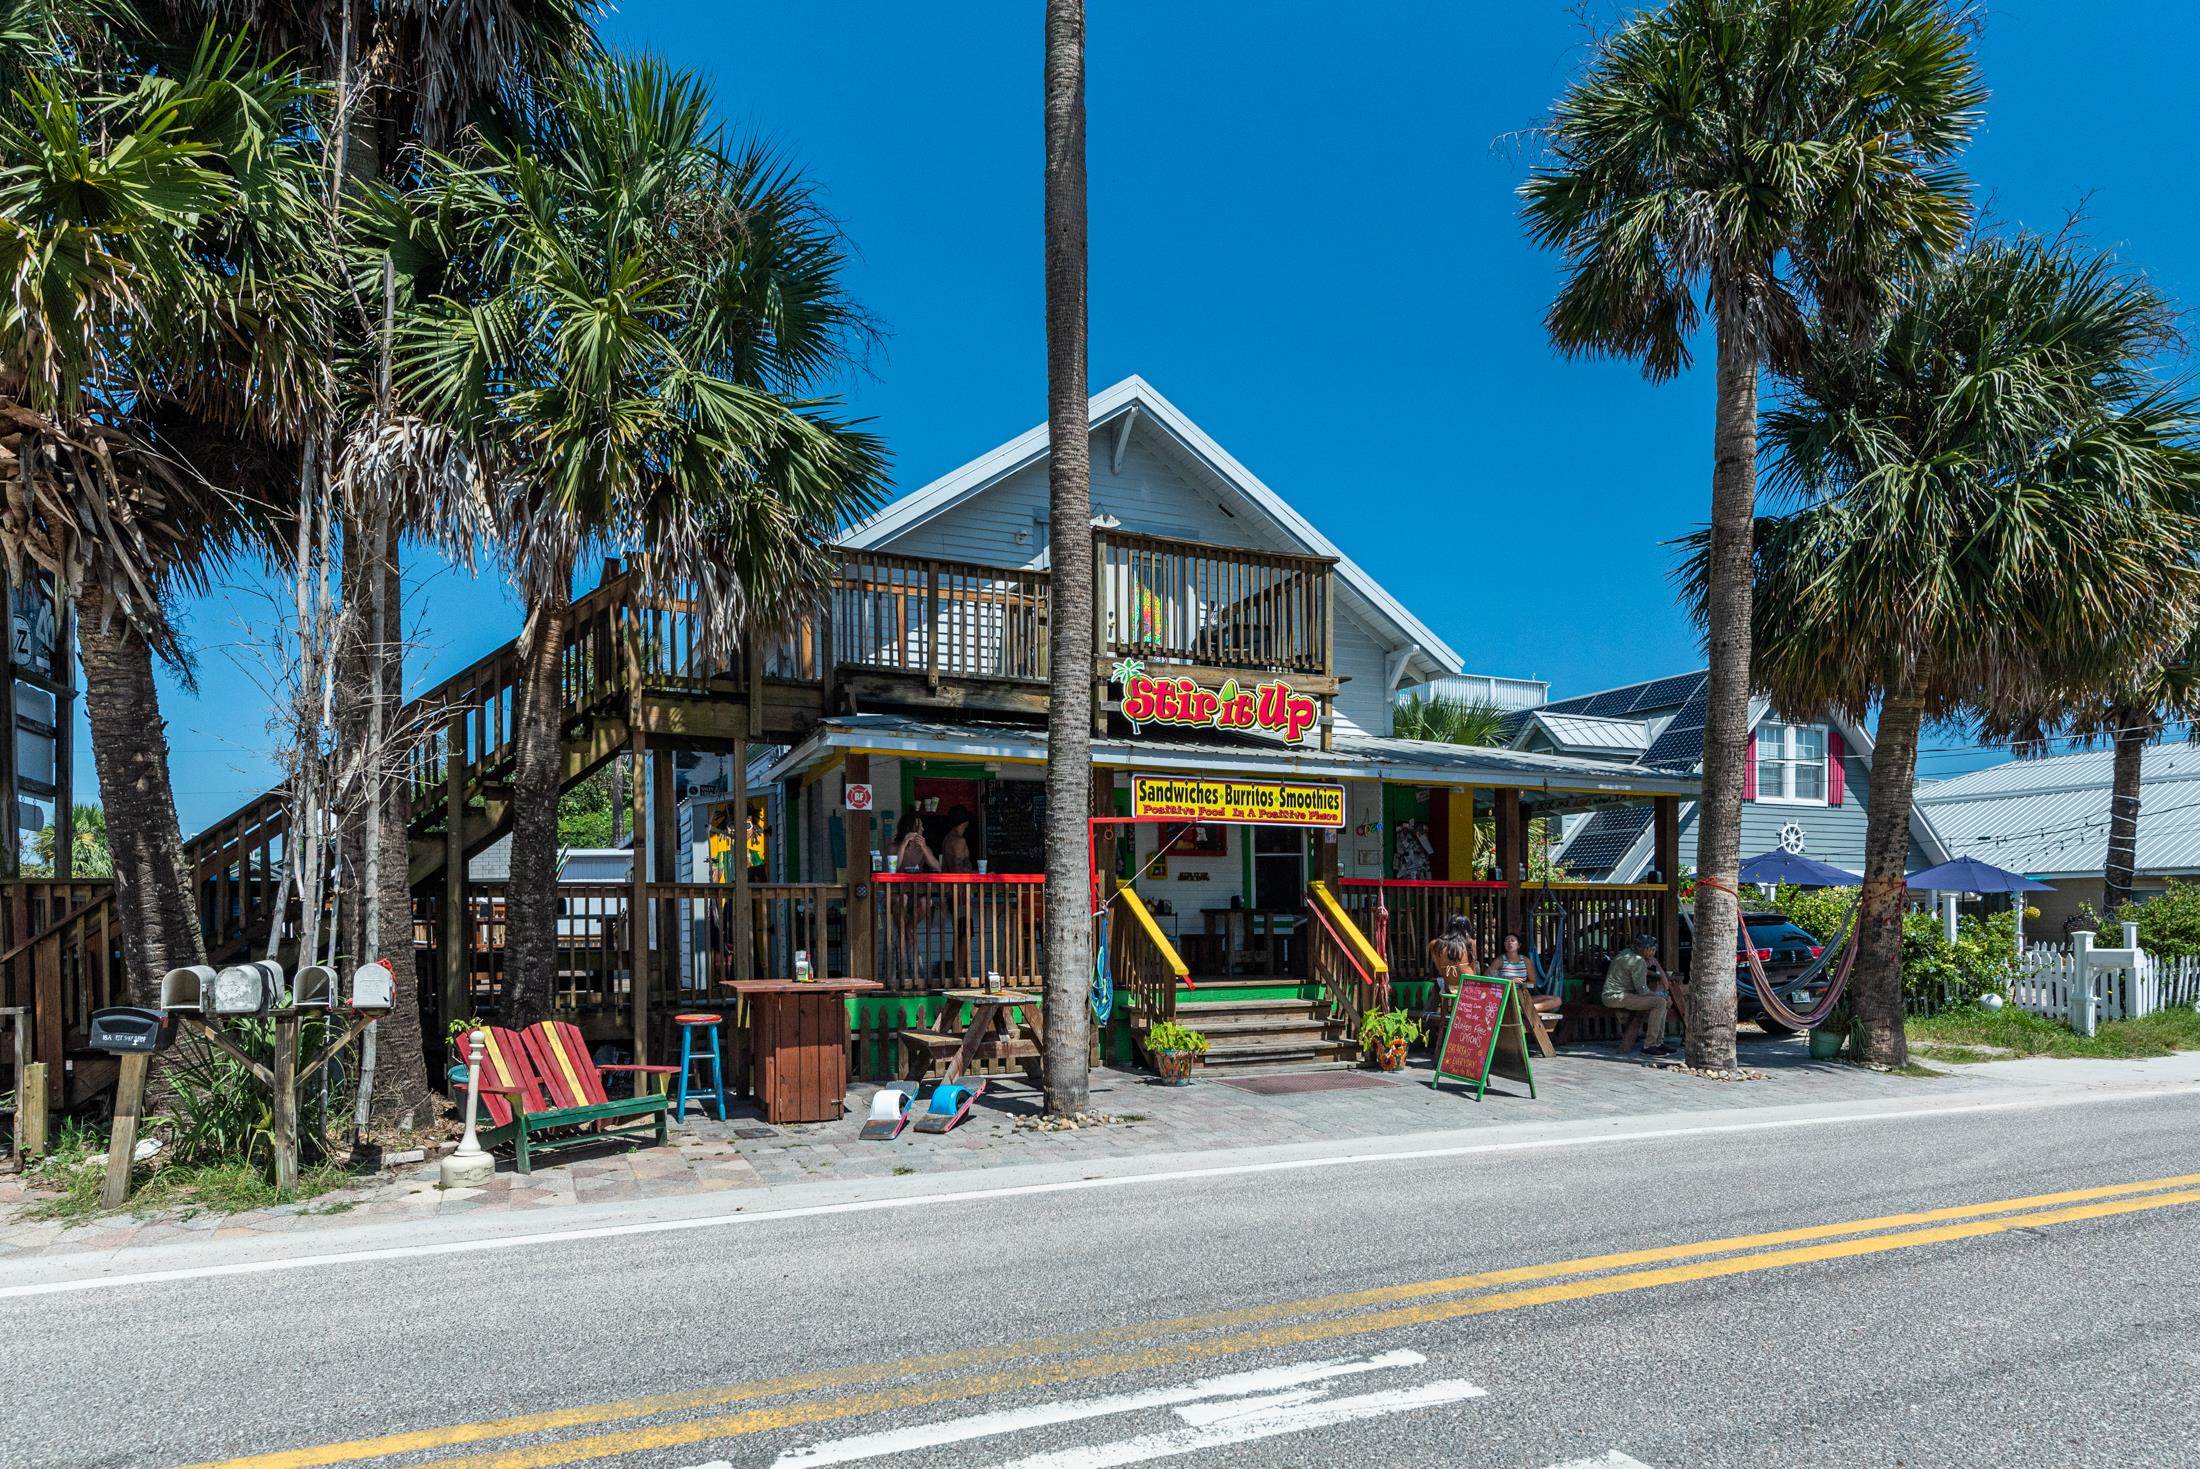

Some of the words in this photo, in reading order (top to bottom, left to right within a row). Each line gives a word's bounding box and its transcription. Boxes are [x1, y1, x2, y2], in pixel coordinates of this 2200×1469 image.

[1122, 675, 1219, 725] Stir
[1218, 681, 1256, 728] it
[1257, 681, 1317, 743] Up
[1139, 780, 1219, 806] Sandwiches
[1225, 784, 1275, 808] Burritos
[1279, 787, 1340, 810] Smoothies
[1143, 804, 1196, 816] Positive
[1198, 806, 1225, 817] Food
[1232, 807, 1244, 818] In
[1247, 808, 1257, 818] A
[1259, 809, 1306, 820] Positive
[1309, 810, 1338, 821] Place
